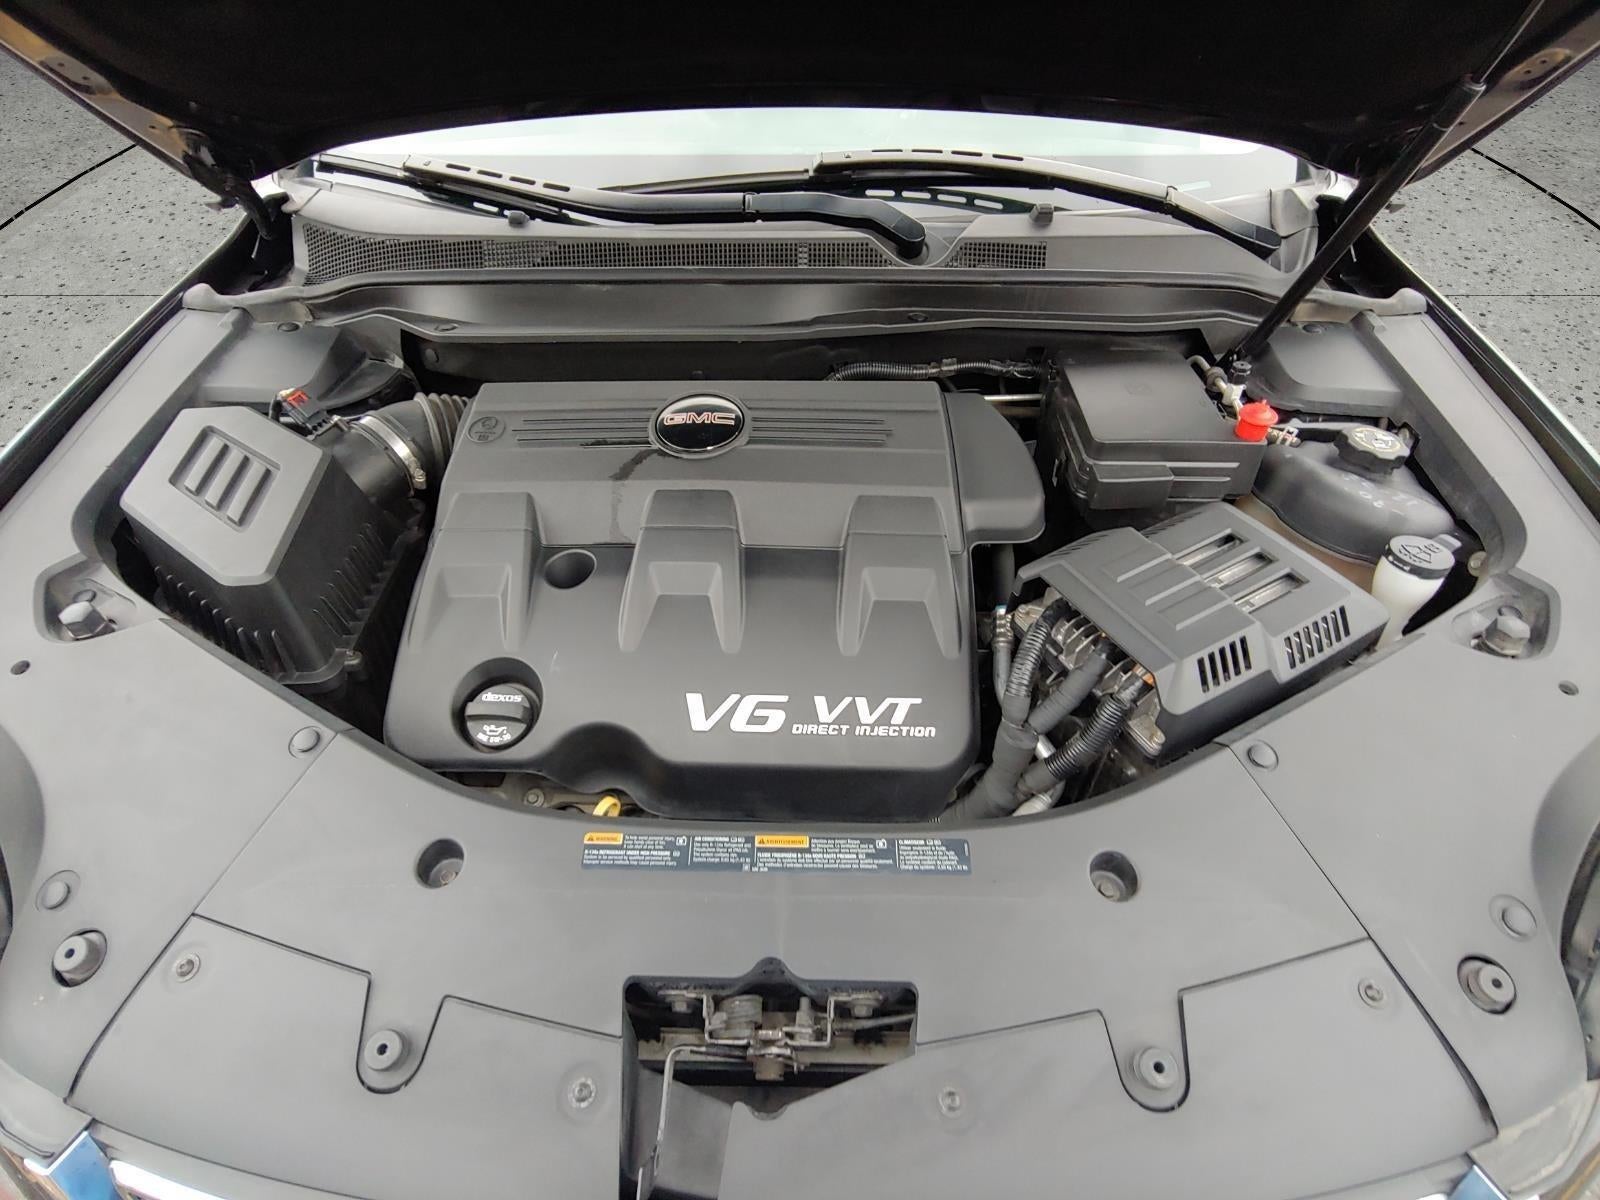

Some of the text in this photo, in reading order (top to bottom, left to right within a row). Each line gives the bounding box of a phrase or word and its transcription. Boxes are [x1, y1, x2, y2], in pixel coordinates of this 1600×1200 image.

[663, 412, 735, 426] GMC
[482, 692, 524, 702] dexos
[685, 692, 923, 733] V6 VVT
[791, 724, 936, 738] DIRECT INJECTION
